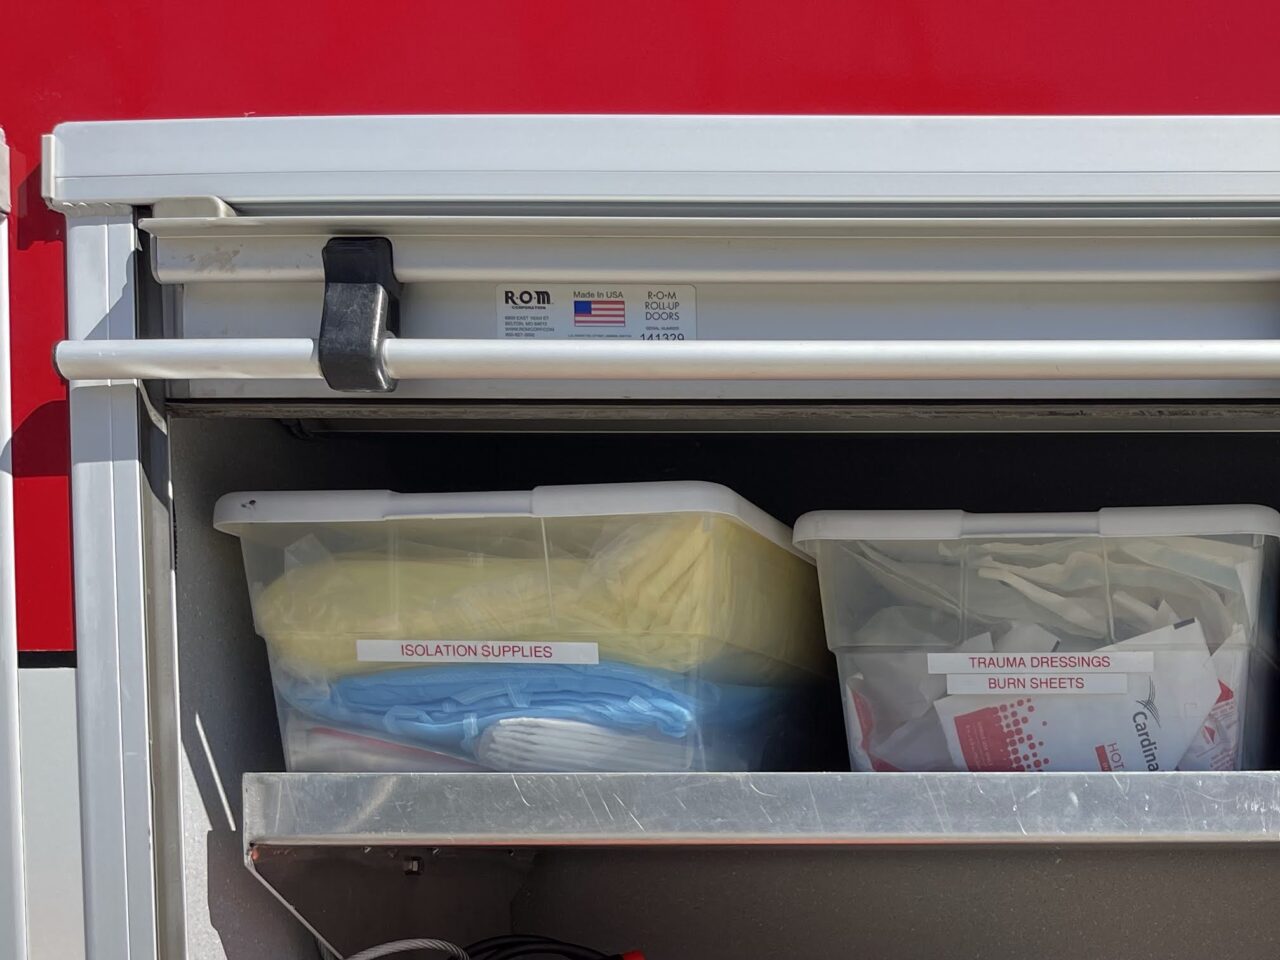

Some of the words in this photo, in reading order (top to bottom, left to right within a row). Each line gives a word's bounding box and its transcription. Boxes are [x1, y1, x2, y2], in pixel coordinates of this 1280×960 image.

[573, 291, 595, 299] Made
[606, 291, 624, 299] USA
[644, 301, 680, 310] ROLL-UP
[645, 312, 680, 321] DOORS
[400, 644, 478, 658] ISOLATION
[480, 644, 553, 658] SUPPLIES
[968, 656, 1026, 669] TRAUMA
[1029, 656, 1111, 669] DRESSINGS
[987, 677, 1026, 689] BURN
[1029, 677, 1085, 689] SHEETS
[1132, 710, 1160, 771] Cardina
[1107, 742, 1125, 769] HOT
